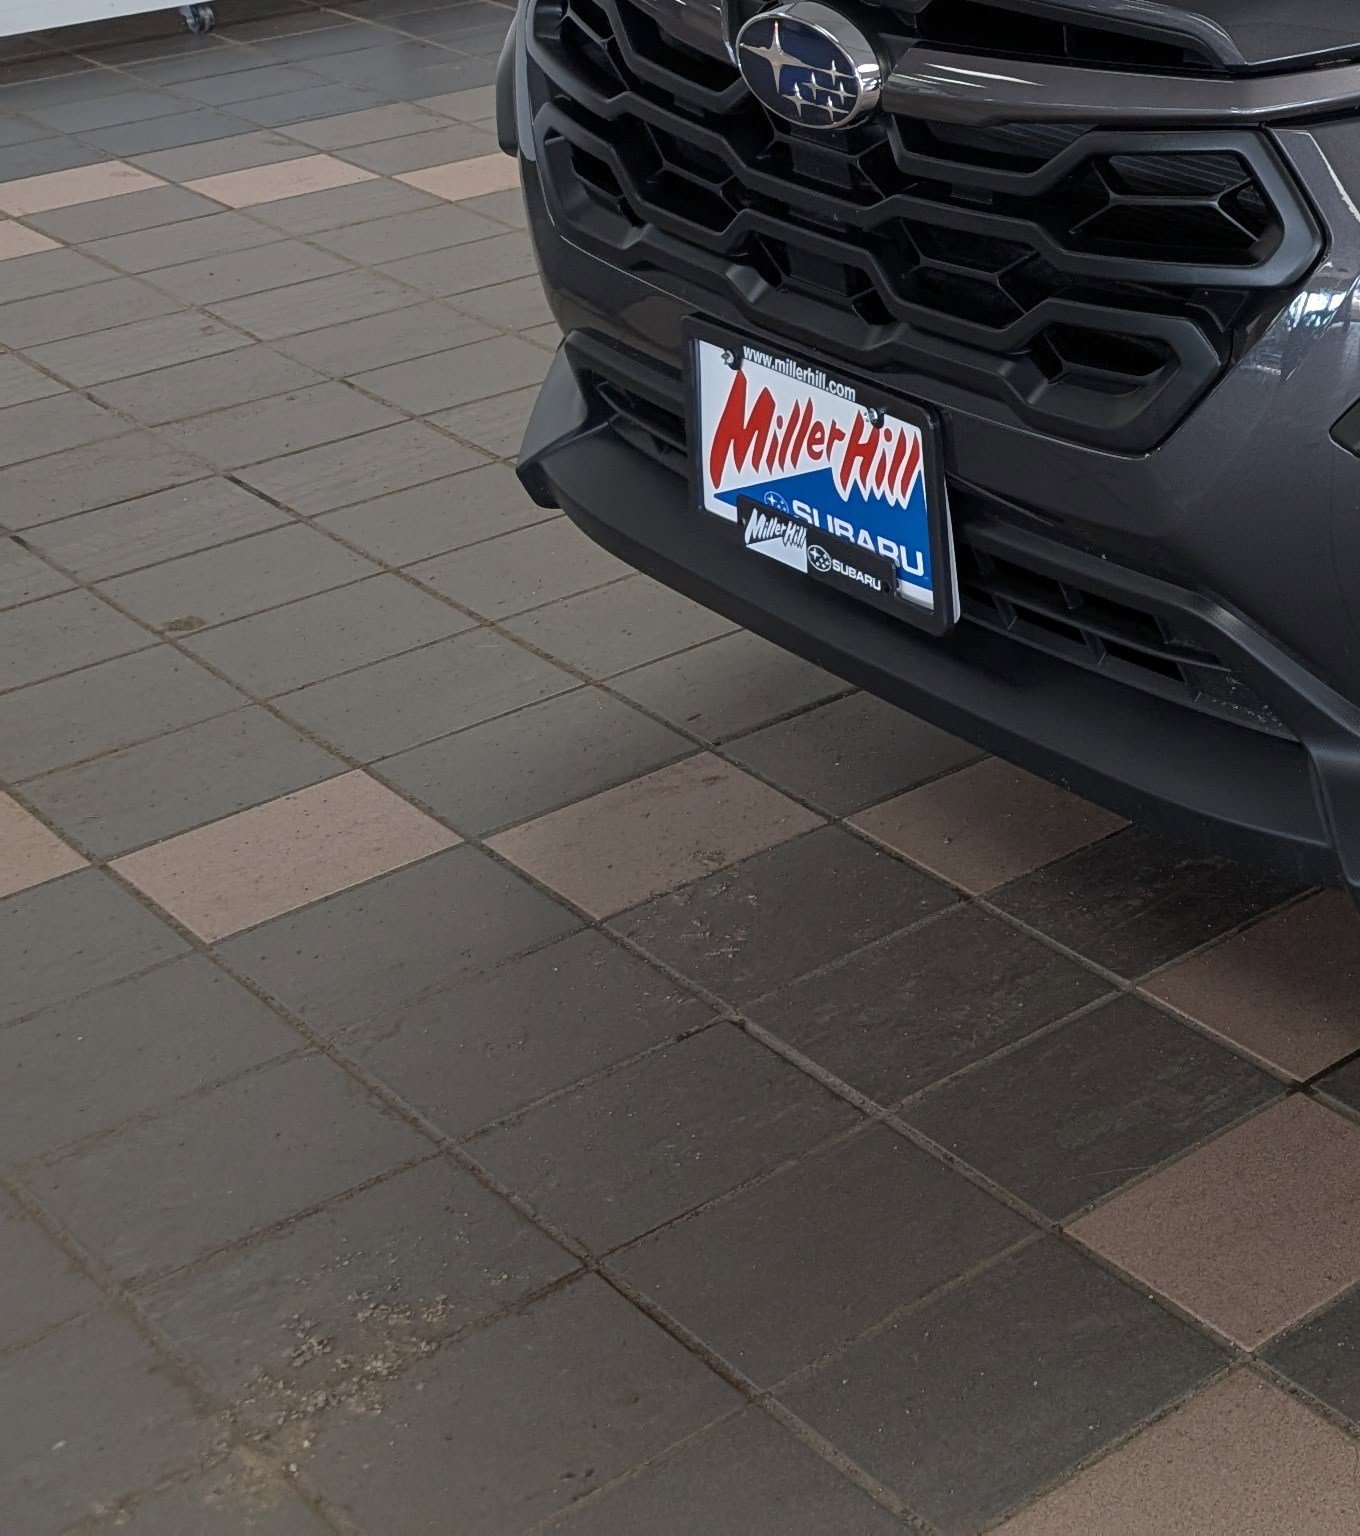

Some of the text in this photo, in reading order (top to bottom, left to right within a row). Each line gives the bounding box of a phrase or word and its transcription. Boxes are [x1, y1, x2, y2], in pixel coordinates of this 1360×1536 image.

[742, 345, 856, 402] www.millerhill.com
[792, 499, 925, 577] SUBARU
[831, 558, 881, 591] SUBARU
